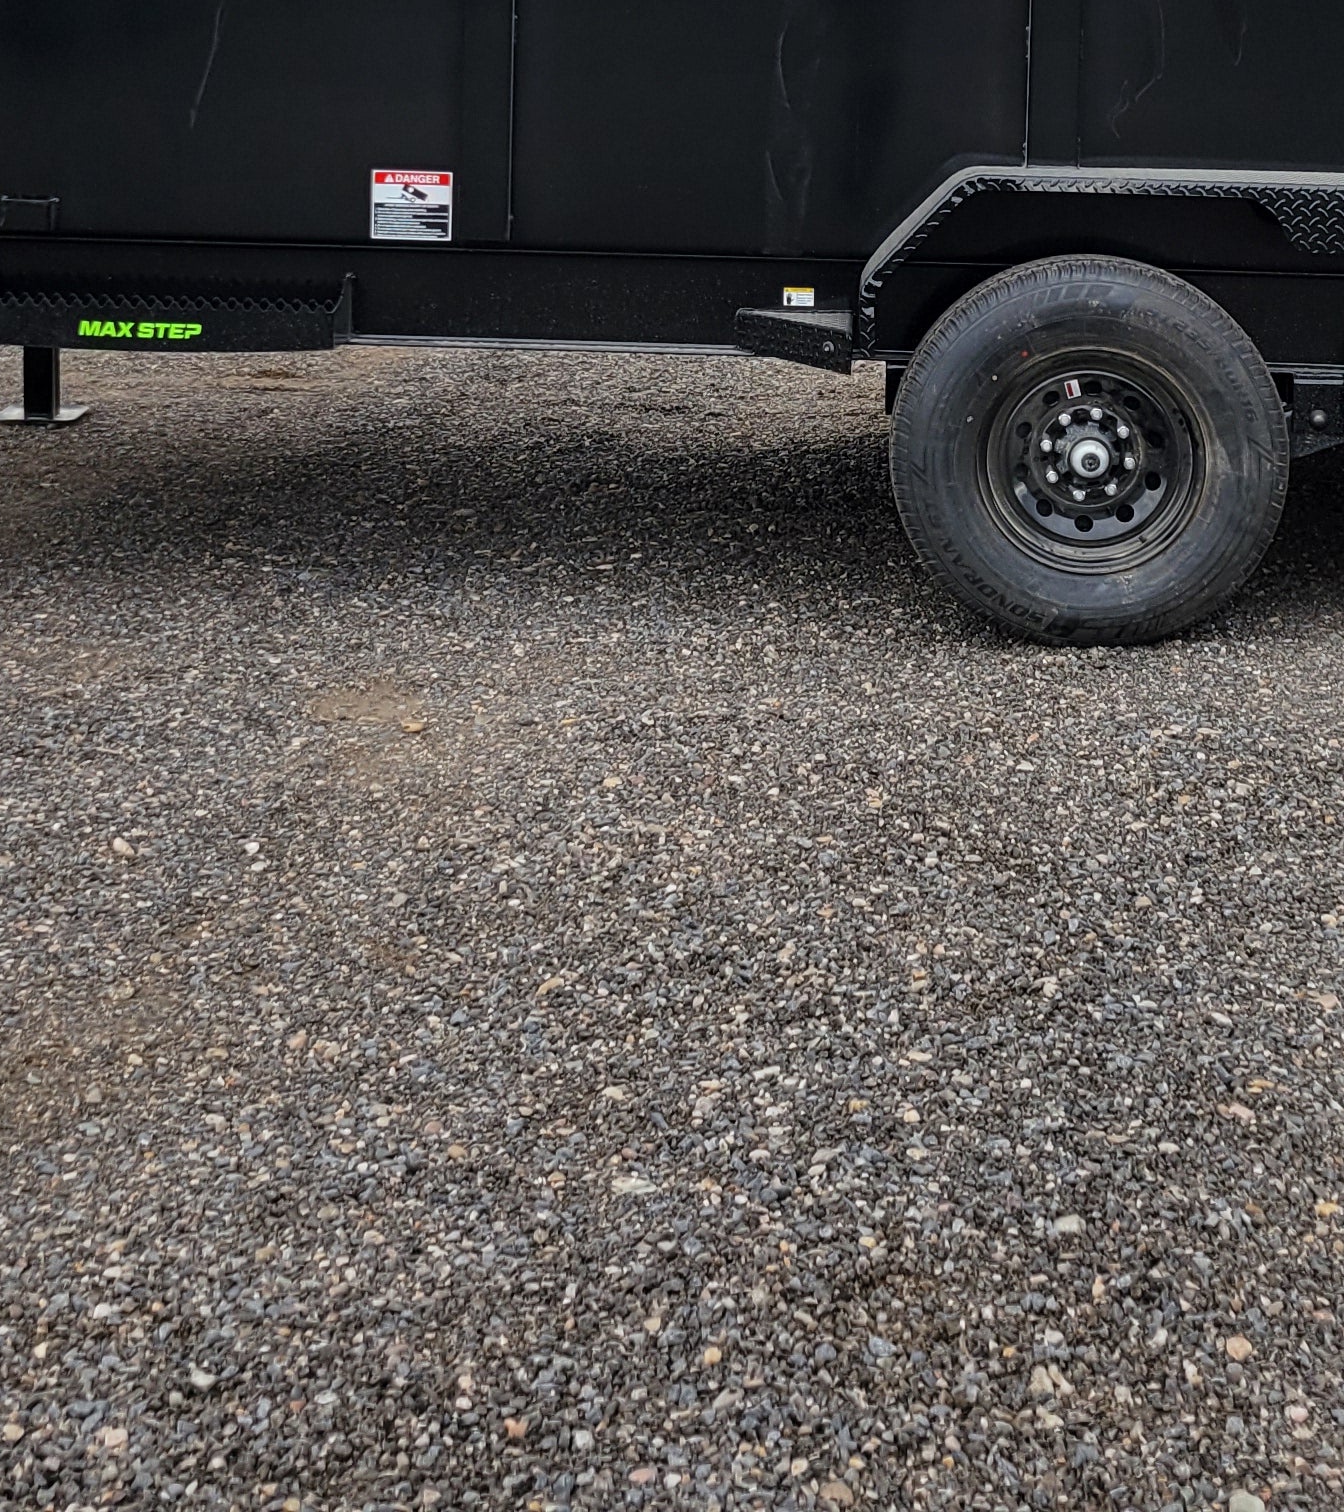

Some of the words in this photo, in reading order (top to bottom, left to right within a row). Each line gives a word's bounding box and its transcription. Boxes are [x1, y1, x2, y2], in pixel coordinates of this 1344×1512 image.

[396, 174, 440, 184] DANGER
[78, 320, 135, 338] MAX
[137, 322, 202, 339] STEP
